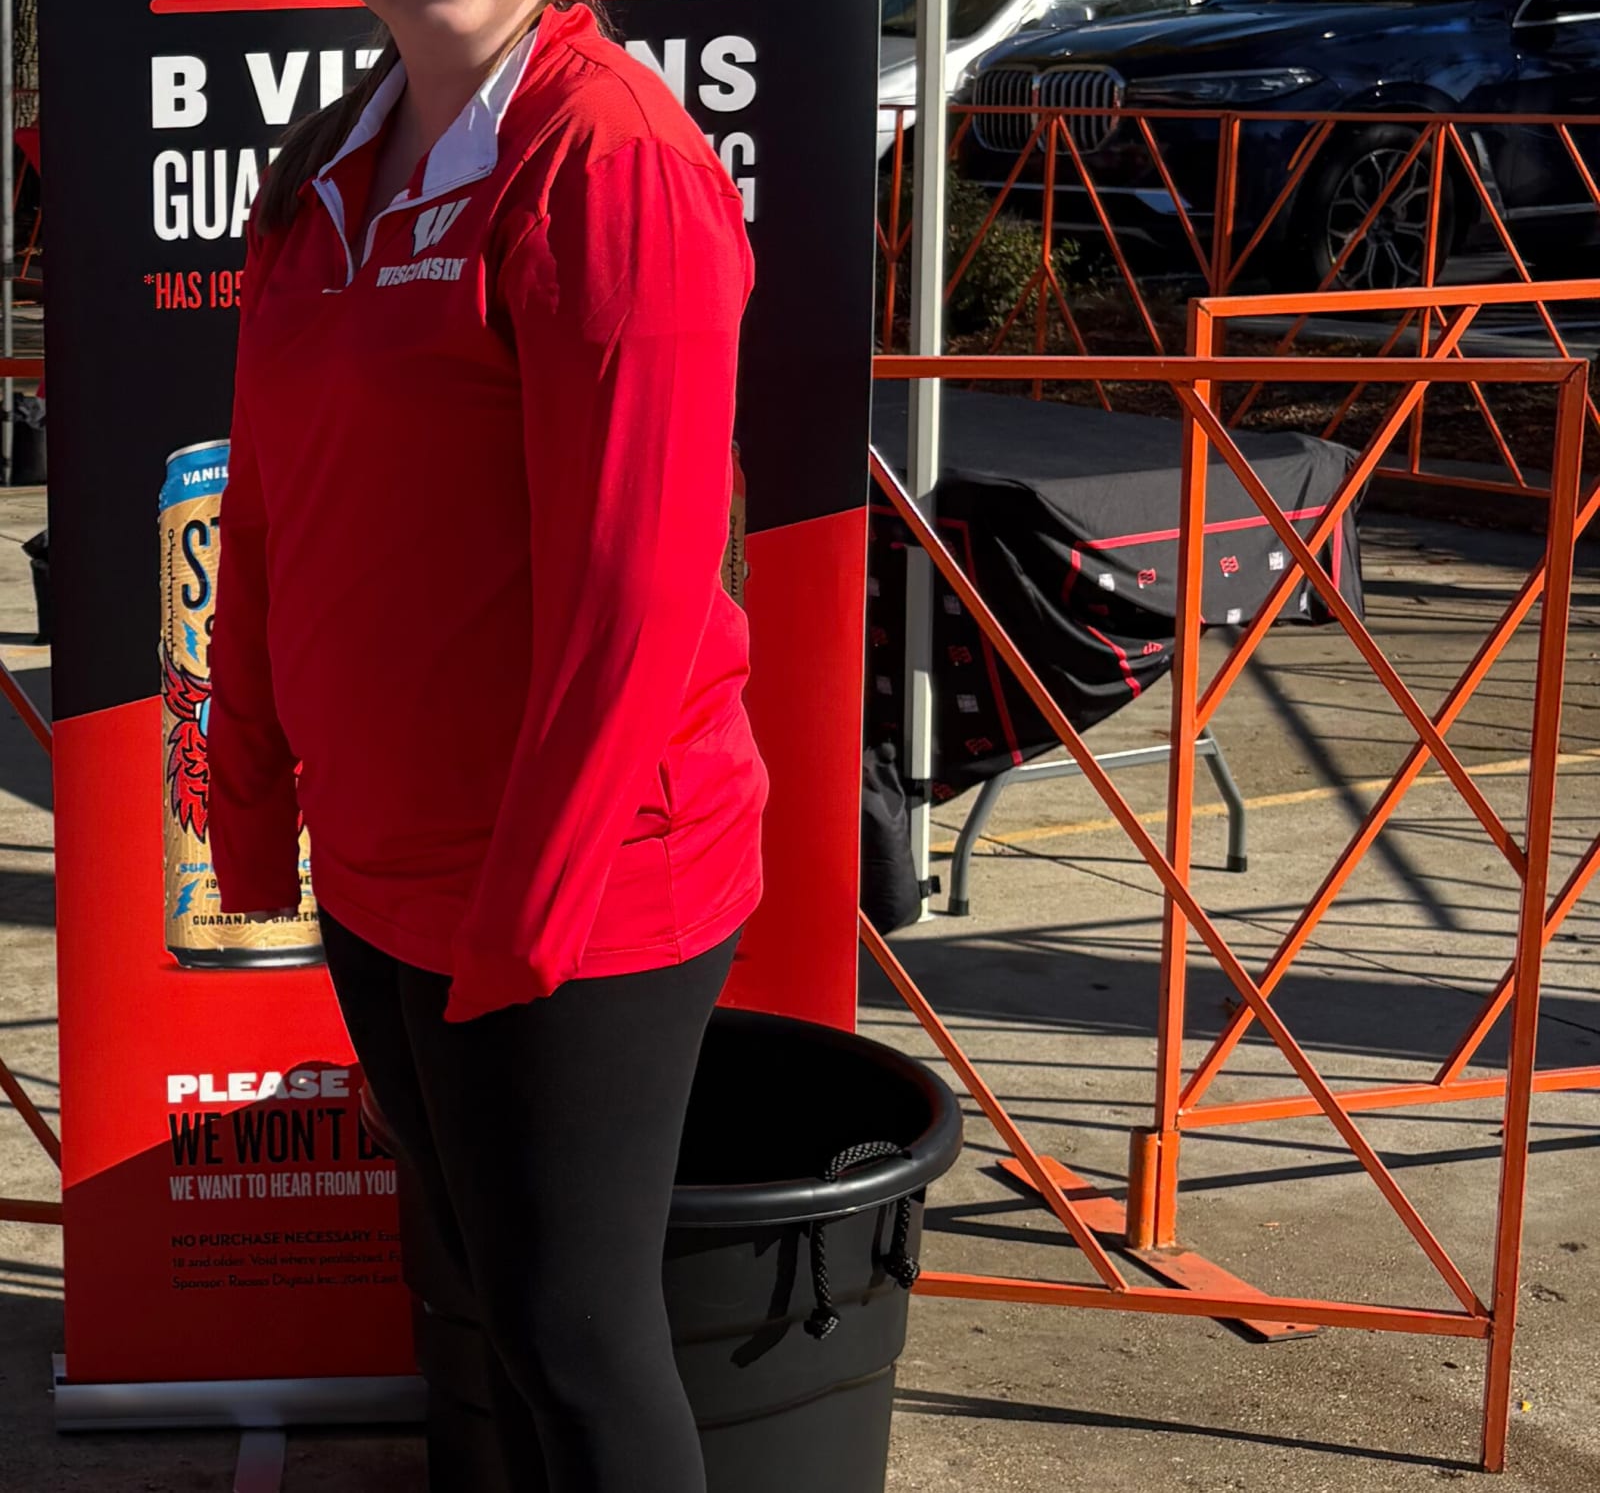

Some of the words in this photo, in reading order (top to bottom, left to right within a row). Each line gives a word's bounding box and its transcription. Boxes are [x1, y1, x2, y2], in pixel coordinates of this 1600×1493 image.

[151, 55, 208, 129] B
[412, 196, 472, 258] W
[376, 257, 468, 288] WISCONSIN
[182, 465, 229, 487] VANIL
[166, 1069, 350, 1104] PLEASE
[169, 1111, 222, 1165] WE
[232, 1107, 346, 1163] WON'T
[169, 1175, 194, 1201] WE
[197, 1173, 244, 1200] WANT
[246, 1173, 266, 1198] TO
[270, 1172, 312, 1198] HEAR
[316, 1170, 361, 1196] FROM
[364, 1169, 397, 1195] YOU
[171, 1234, 196, 1247] NO
[199, 1232, 281, 1246] PURCHASE
